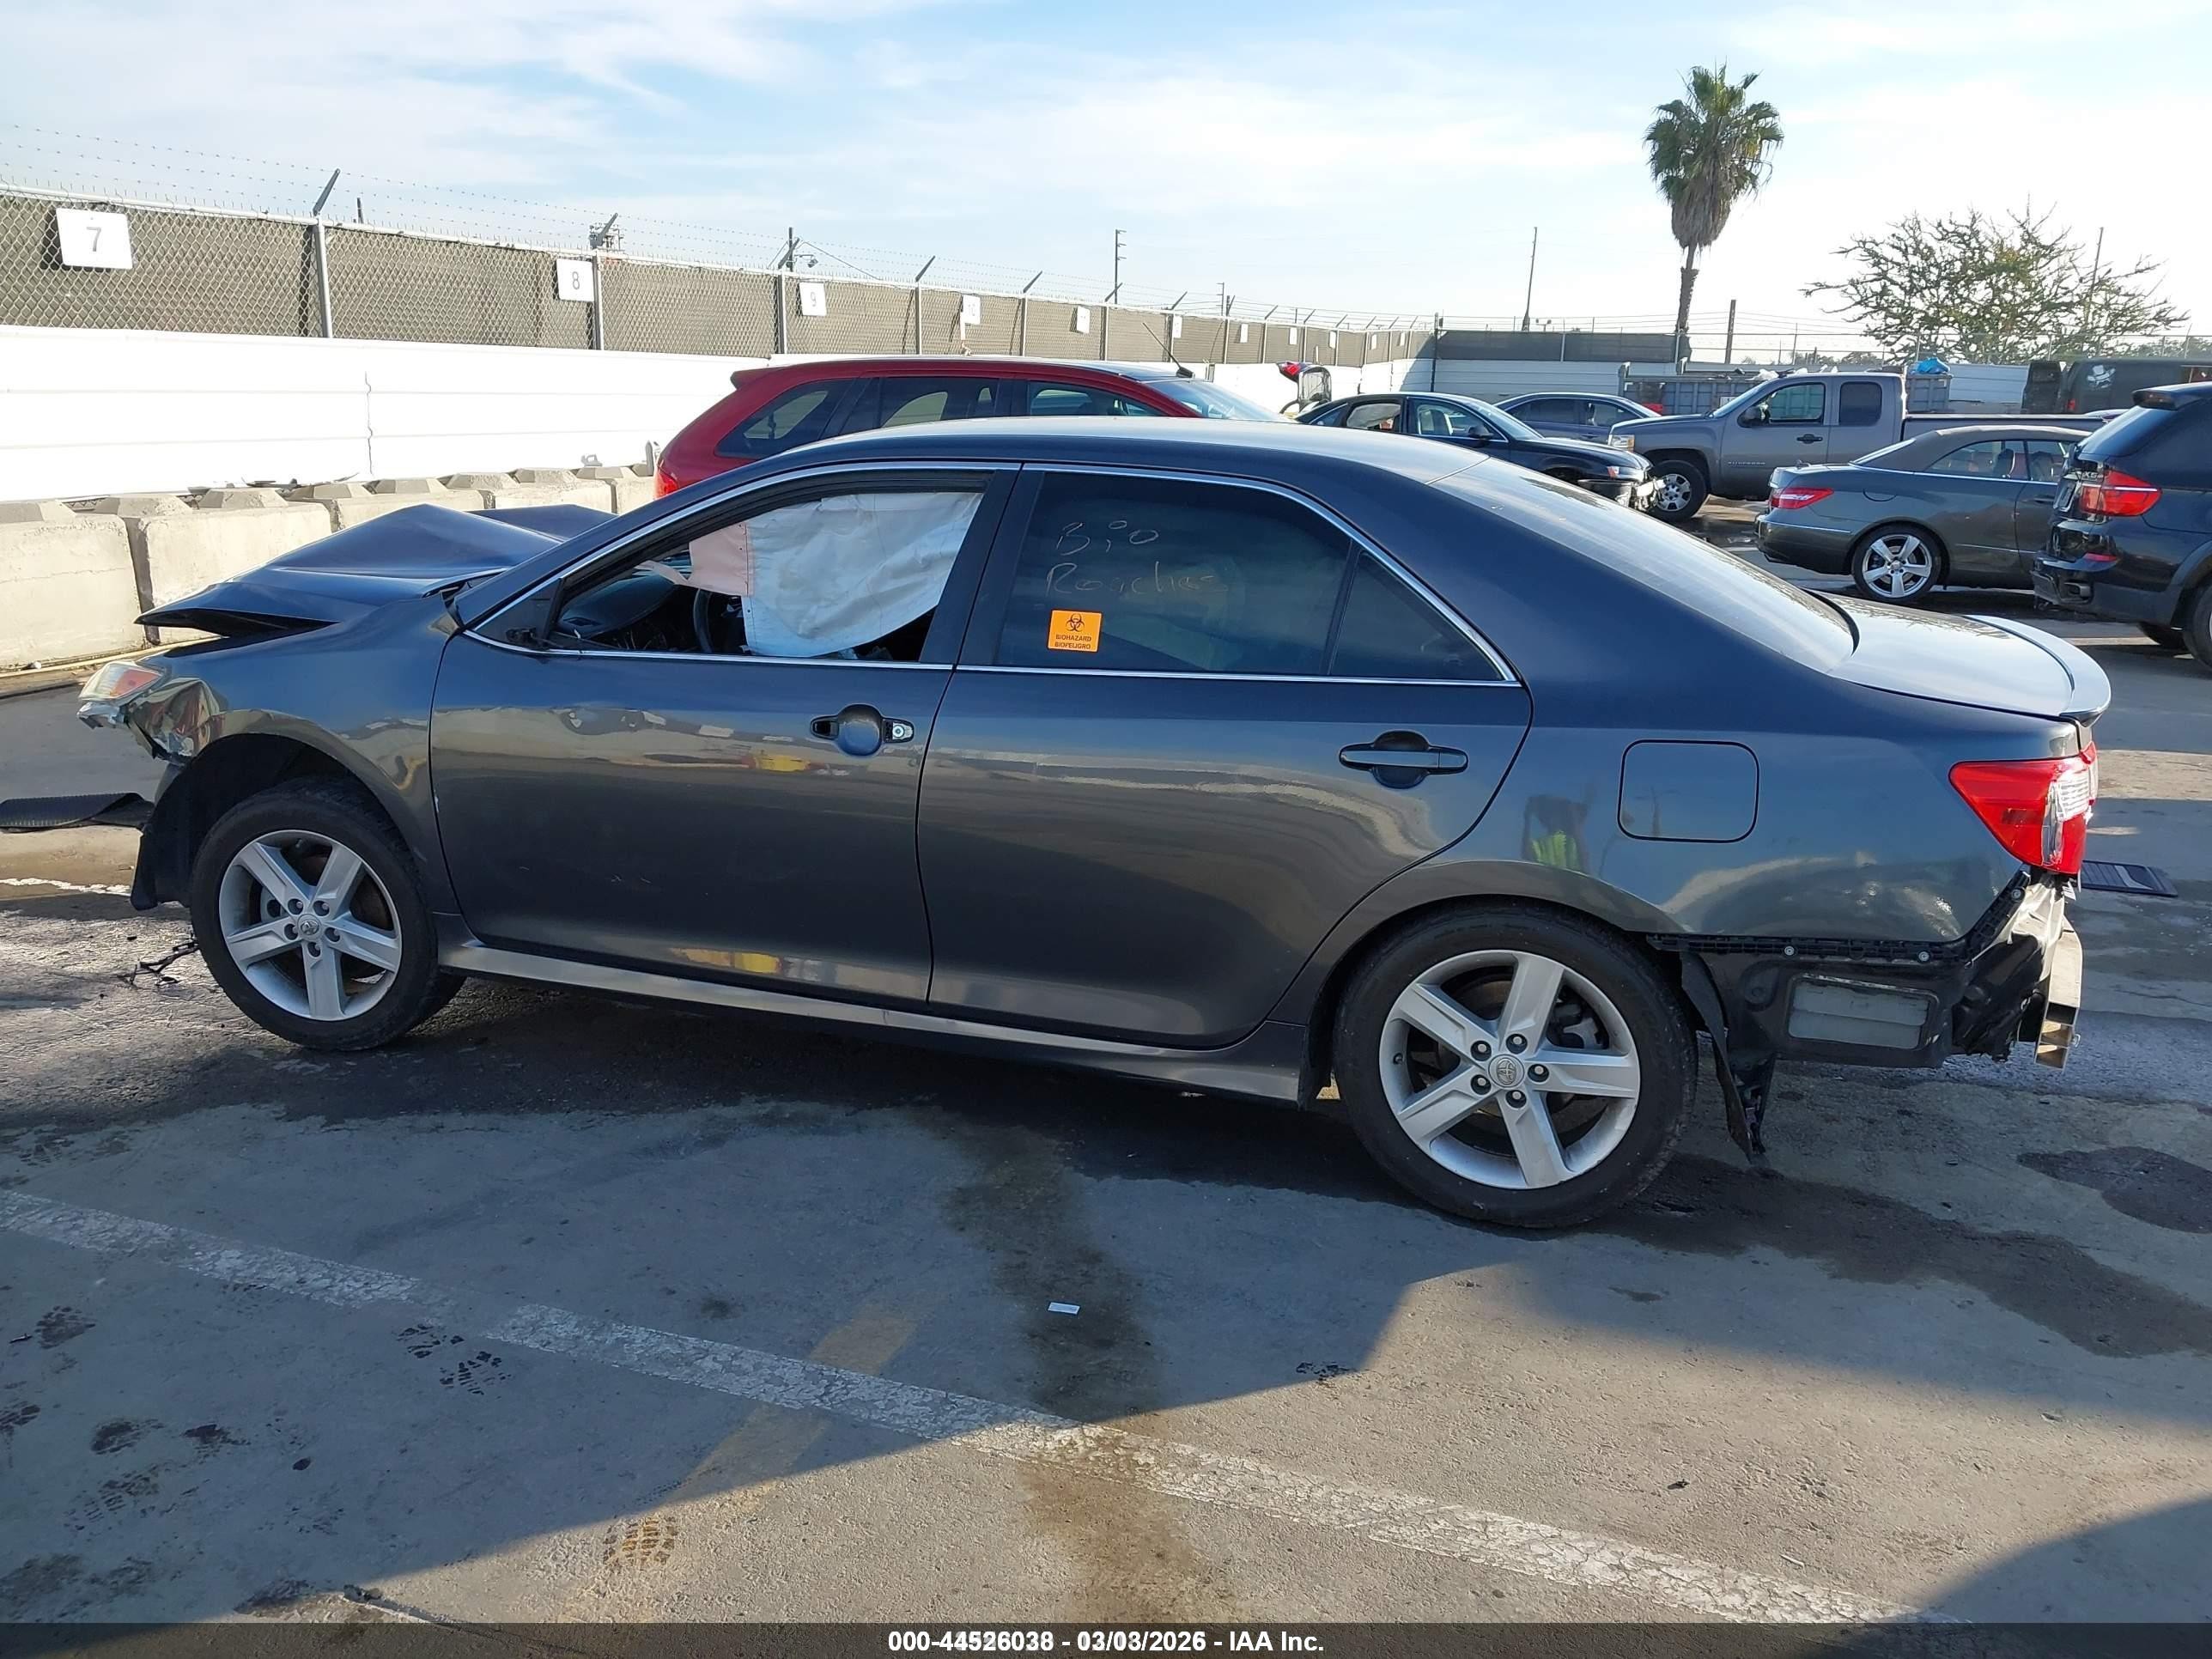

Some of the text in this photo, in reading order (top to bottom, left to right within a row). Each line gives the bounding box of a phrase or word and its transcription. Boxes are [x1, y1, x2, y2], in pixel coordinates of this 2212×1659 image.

[86, 226, 102, 252] 7
[572, 270, 580, 290] 8
[810, 291, 817, 307] 9
[1055, 520, 1159, 556] Bio
[1054, 641, 1091, 650] BIOPELIGRO
[1055, 634, 1092, 642] BIOHAZARD
